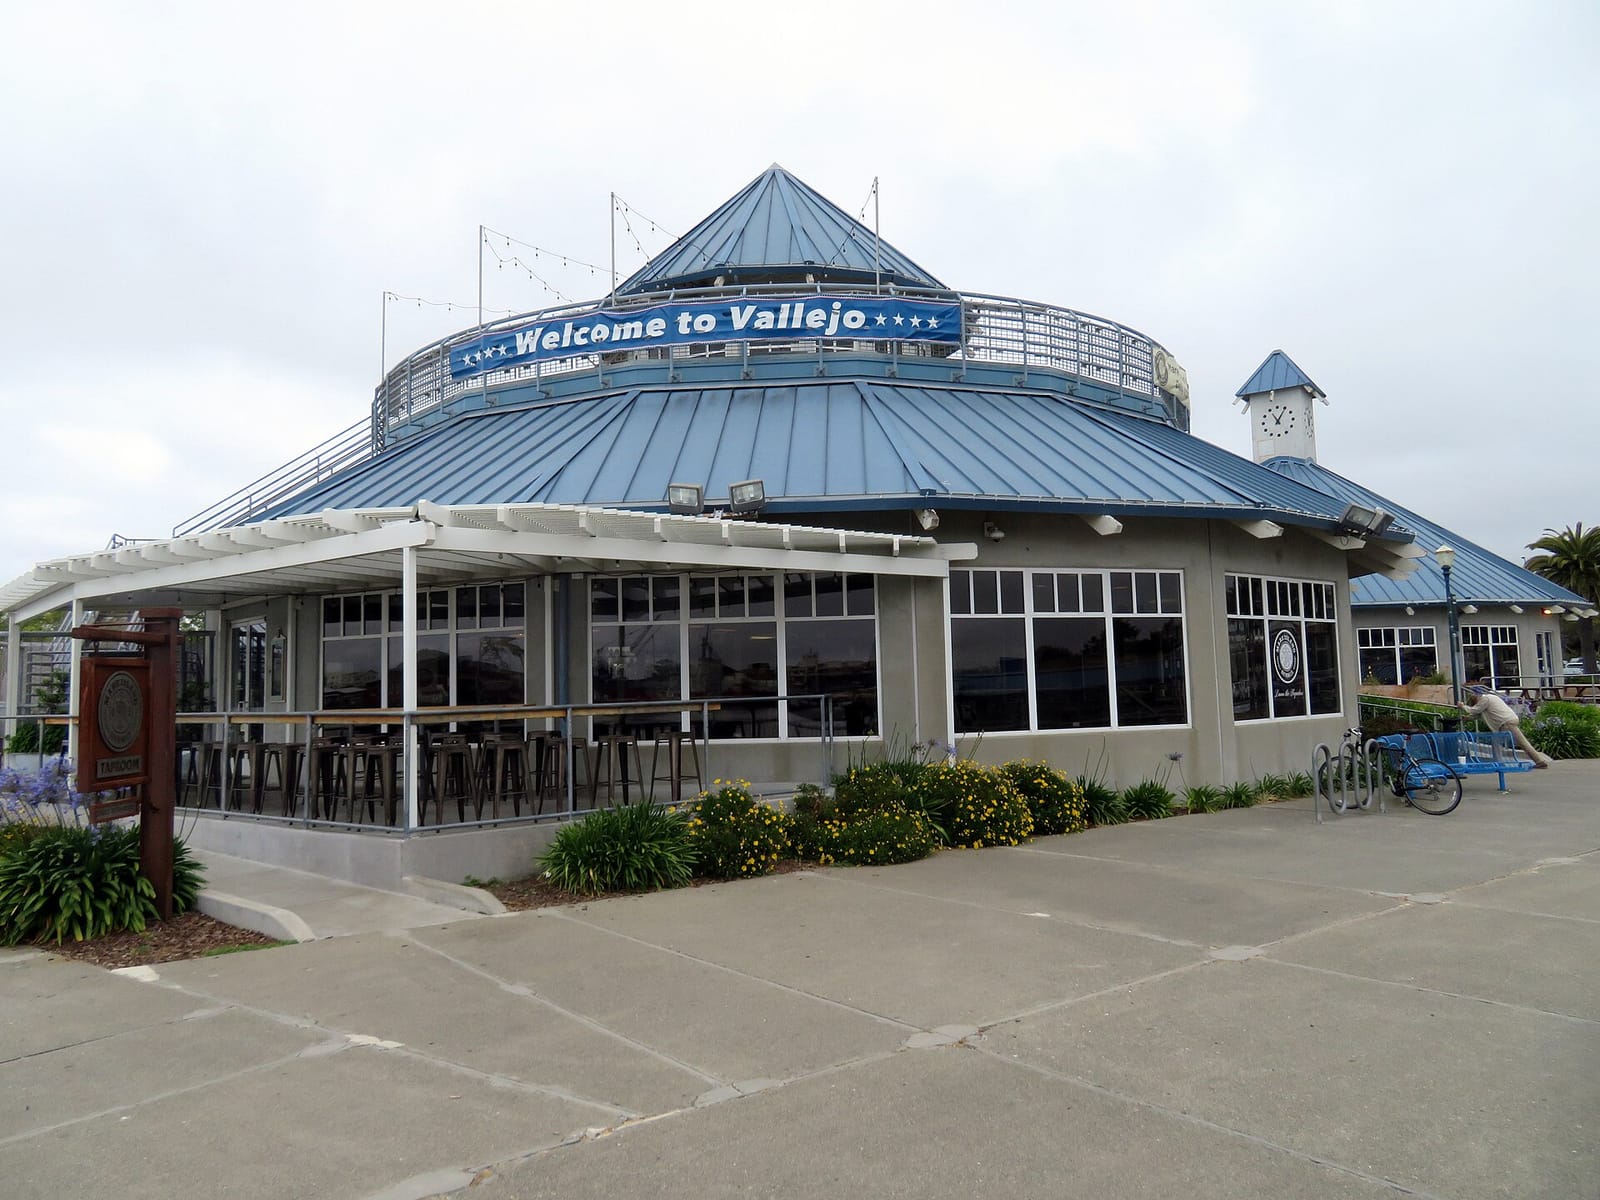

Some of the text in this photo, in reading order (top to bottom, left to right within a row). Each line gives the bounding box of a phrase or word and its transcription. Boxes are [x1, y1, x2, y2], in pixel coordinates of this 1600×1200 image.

[515, 301, 866, 355] Welcome to Vallejo
